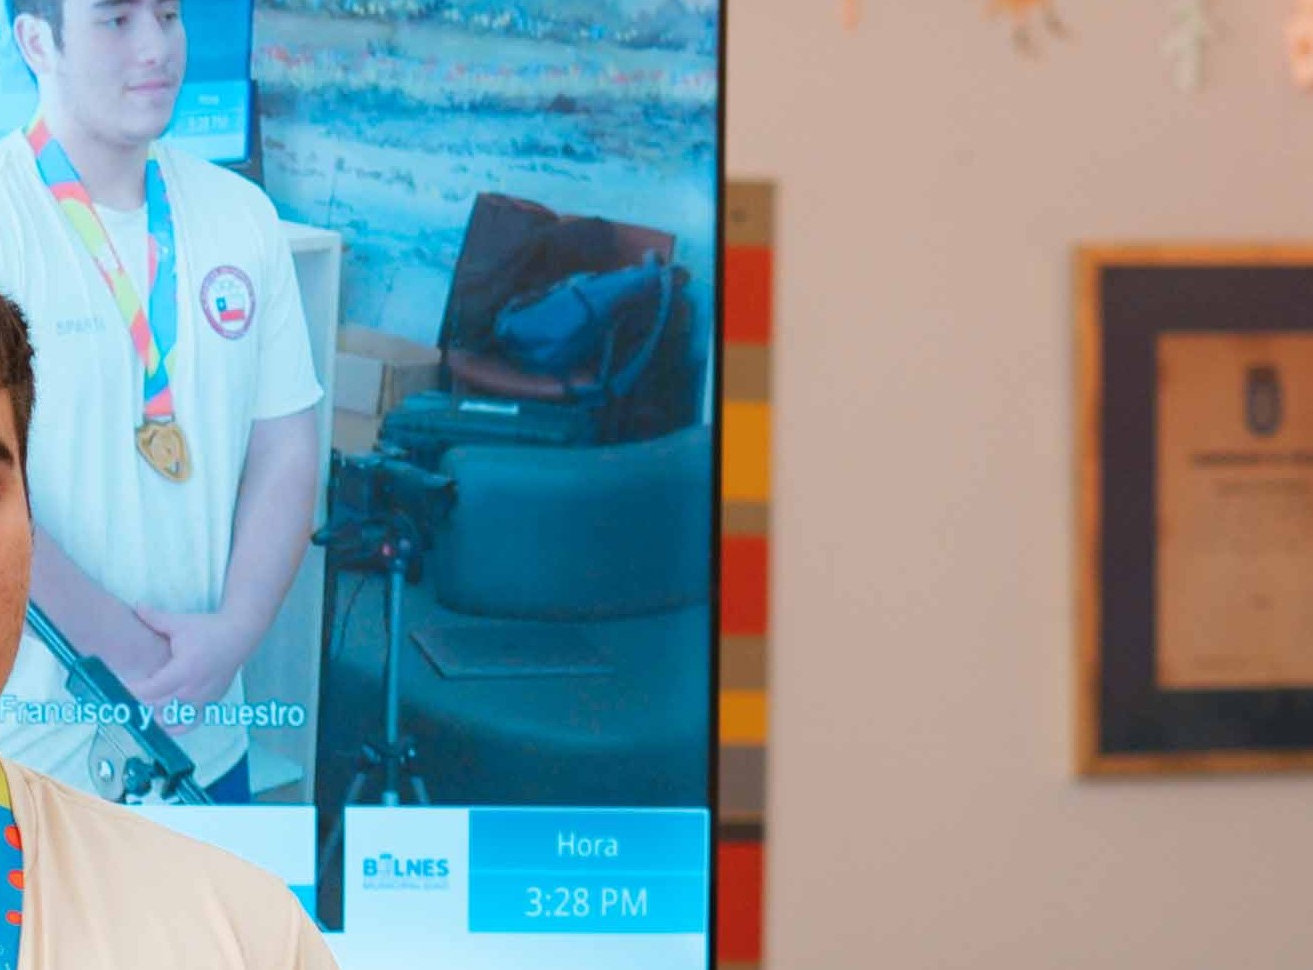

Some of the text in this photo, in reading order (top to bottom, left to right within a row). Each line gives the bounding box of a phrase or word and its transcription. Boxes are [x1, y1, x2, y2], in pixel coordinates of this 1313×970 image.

[139, 704, 156, 730] y
[162, 699, 196, 726] de
[204, 700, 305, 727] nuestro
[557, 831, 619, 858] Hora
[525, 887, 648, 917] 3:28 PM
